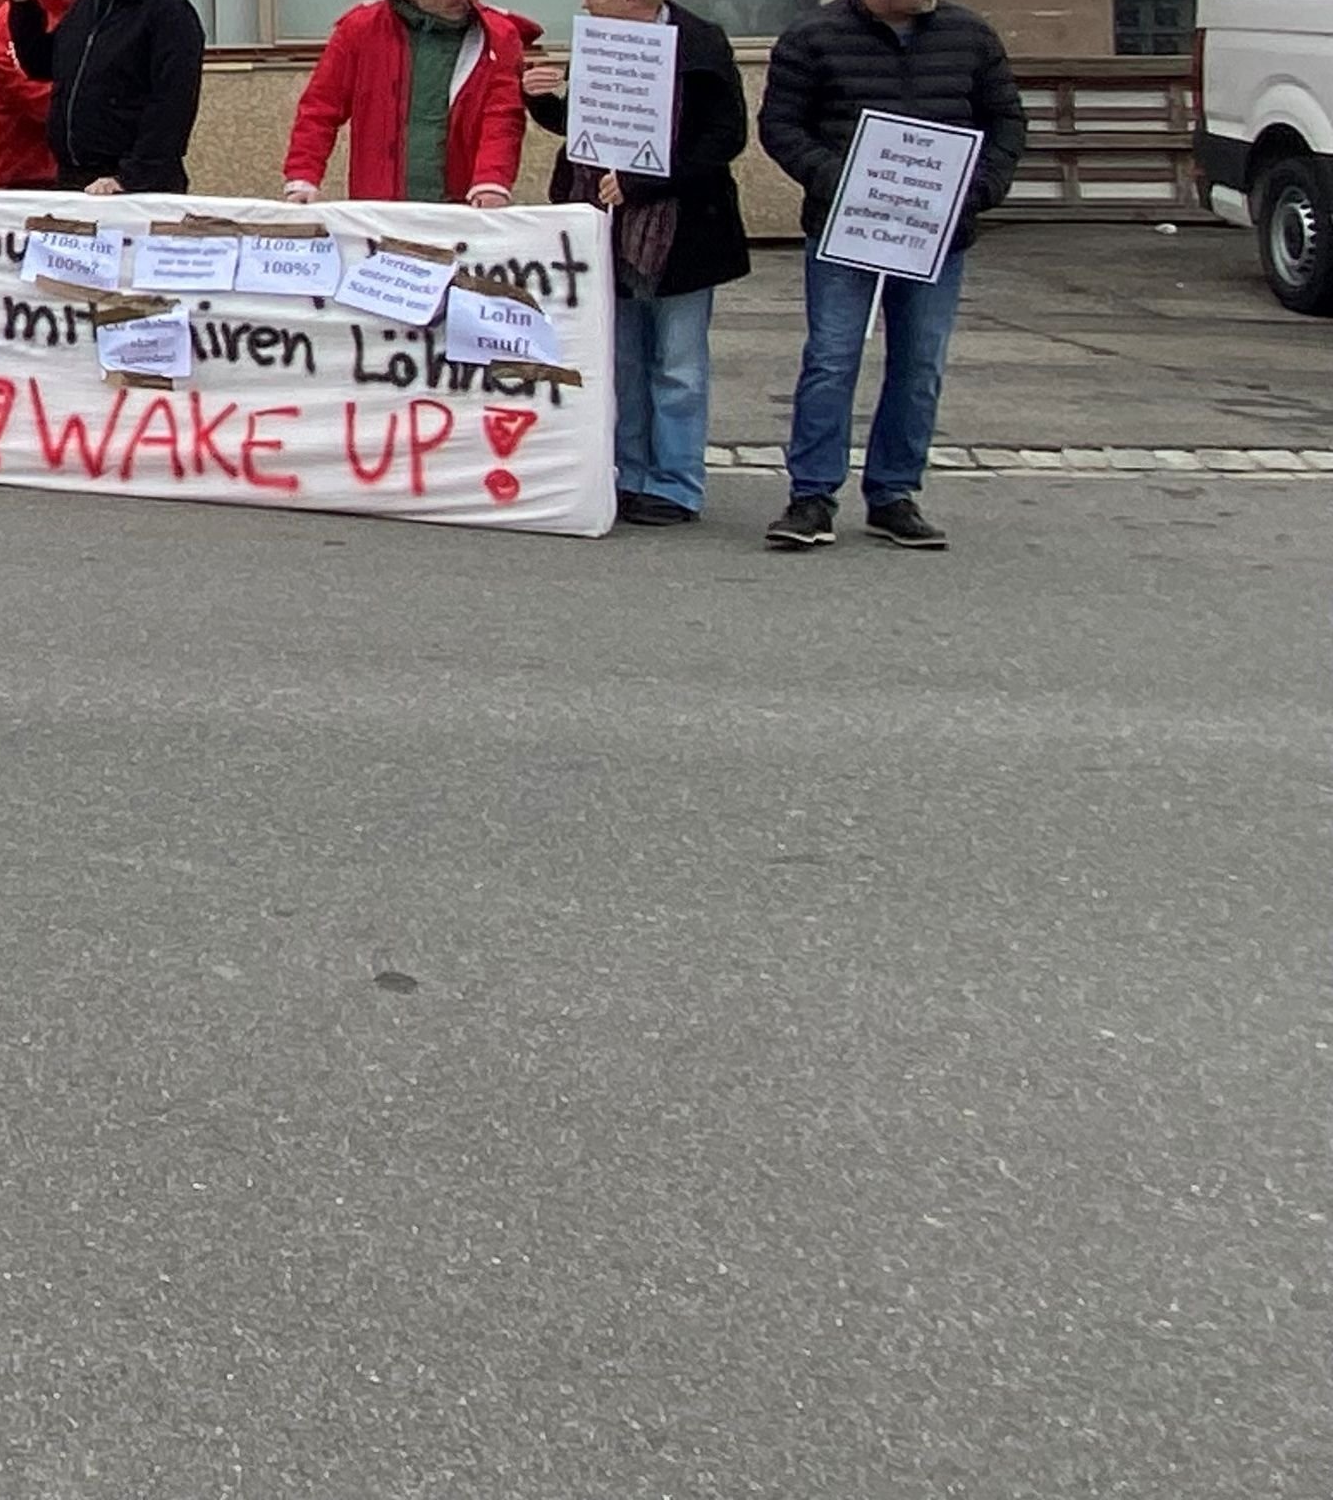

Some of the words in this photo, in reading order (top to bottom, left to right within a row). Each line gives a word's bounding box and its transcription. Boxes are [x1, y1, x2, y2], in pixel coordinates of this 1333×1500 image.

[880, 148, 942, 171] Respekt
[868, 187, 931, 210] Respekt
[479, 305, 533, 328] Lohn
[29, 376, 302, 495] WAKE
[344, 397, 453, 500] UP
